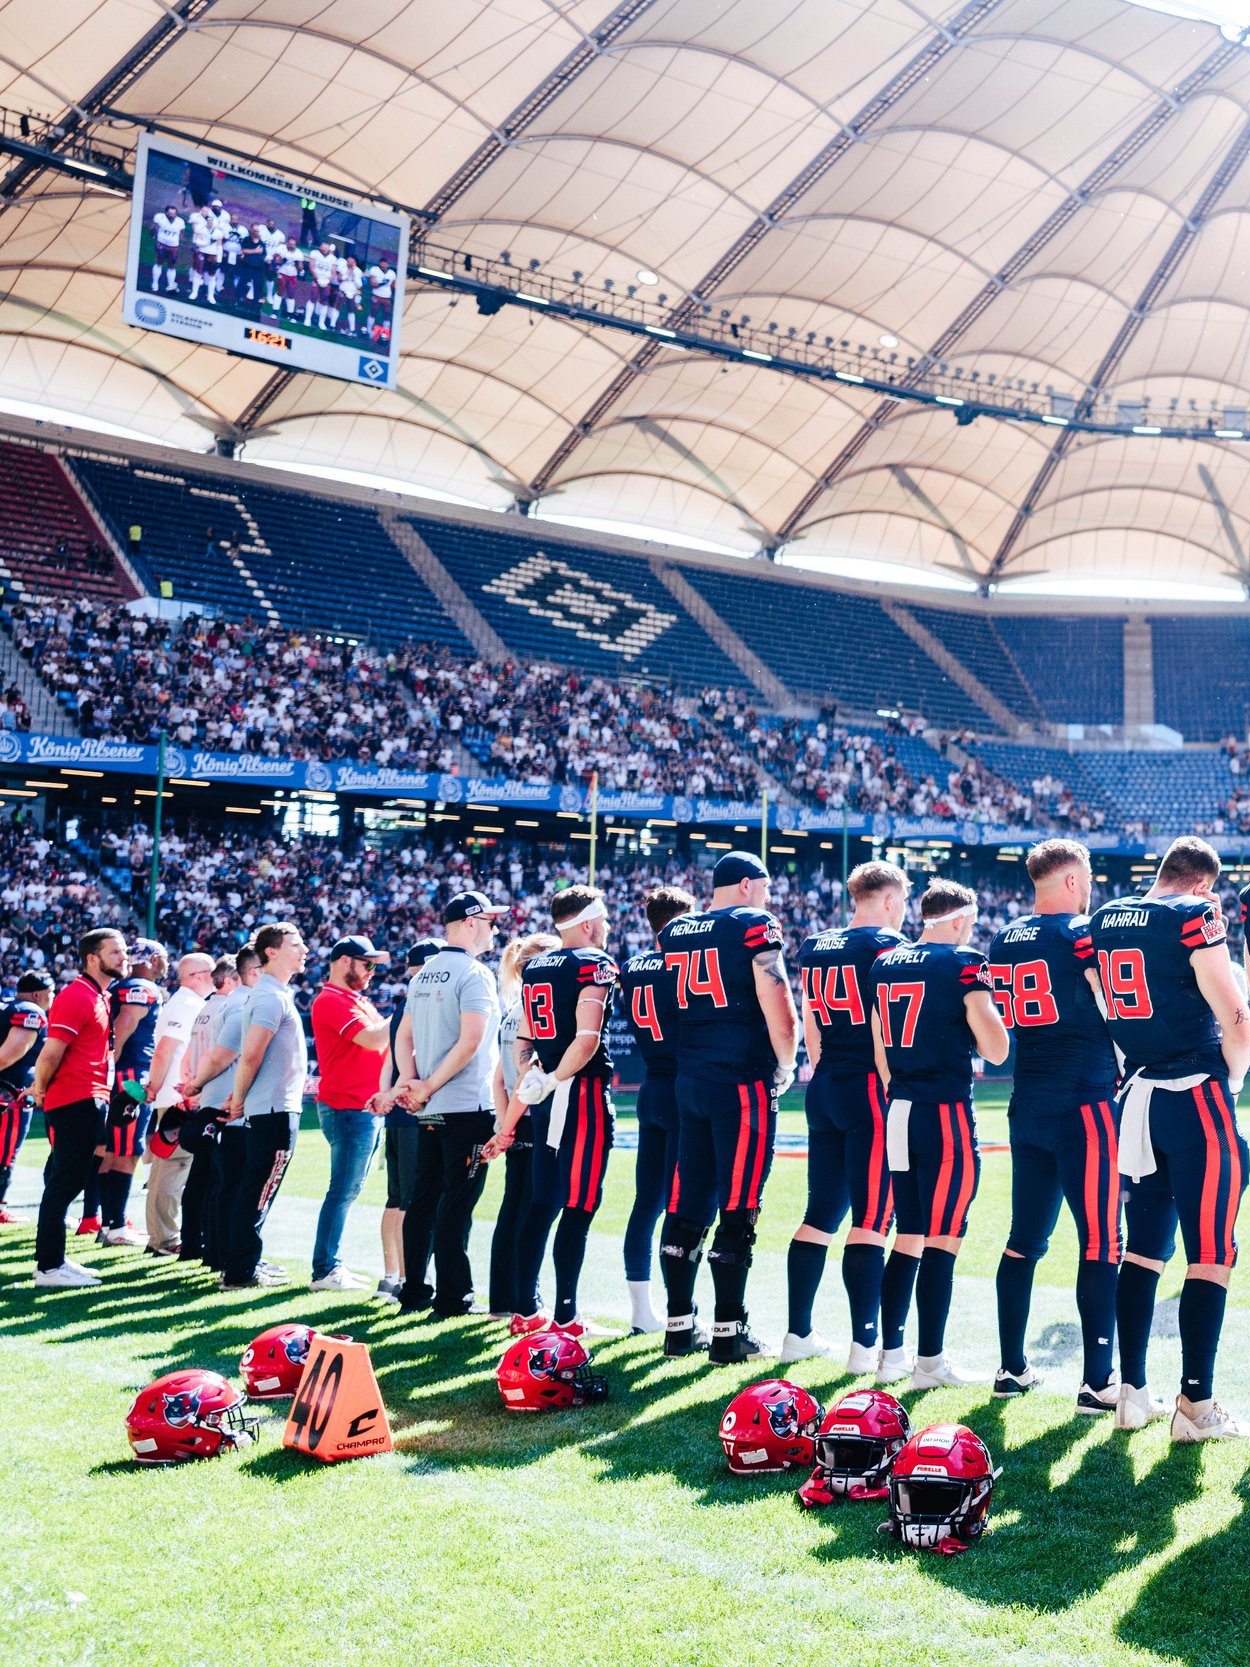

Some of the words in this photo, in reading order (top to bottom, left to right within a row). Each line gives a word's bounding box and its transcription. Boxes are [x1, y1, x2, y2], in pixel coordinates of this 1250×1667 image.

[207, 156, 293, 190] WILLKOMMEN
[670, 920, 715, 937] HENZLER
[1004, 926, 1040, 944] LOHSE
[1101, 911, 1149, 929] KAHRAU
[526, 955, 567, 971] ALBRECHT
[882, 951, 930, 966] APPELT
[665, 948, 728, 1009] 74
[801, 965, 865, 1025] 44
[1098, 948, 1153, 1019] 19
[523, 983, 556, 1039] 13
[632, 985, 663, 1041] 4
[877, 981, 925, 1047] 17
[290, 1349, 343, 1450] 40
[336, 1437, 385, 1450] CHAMPRO
[723, 1440, 734, 1456] 17
